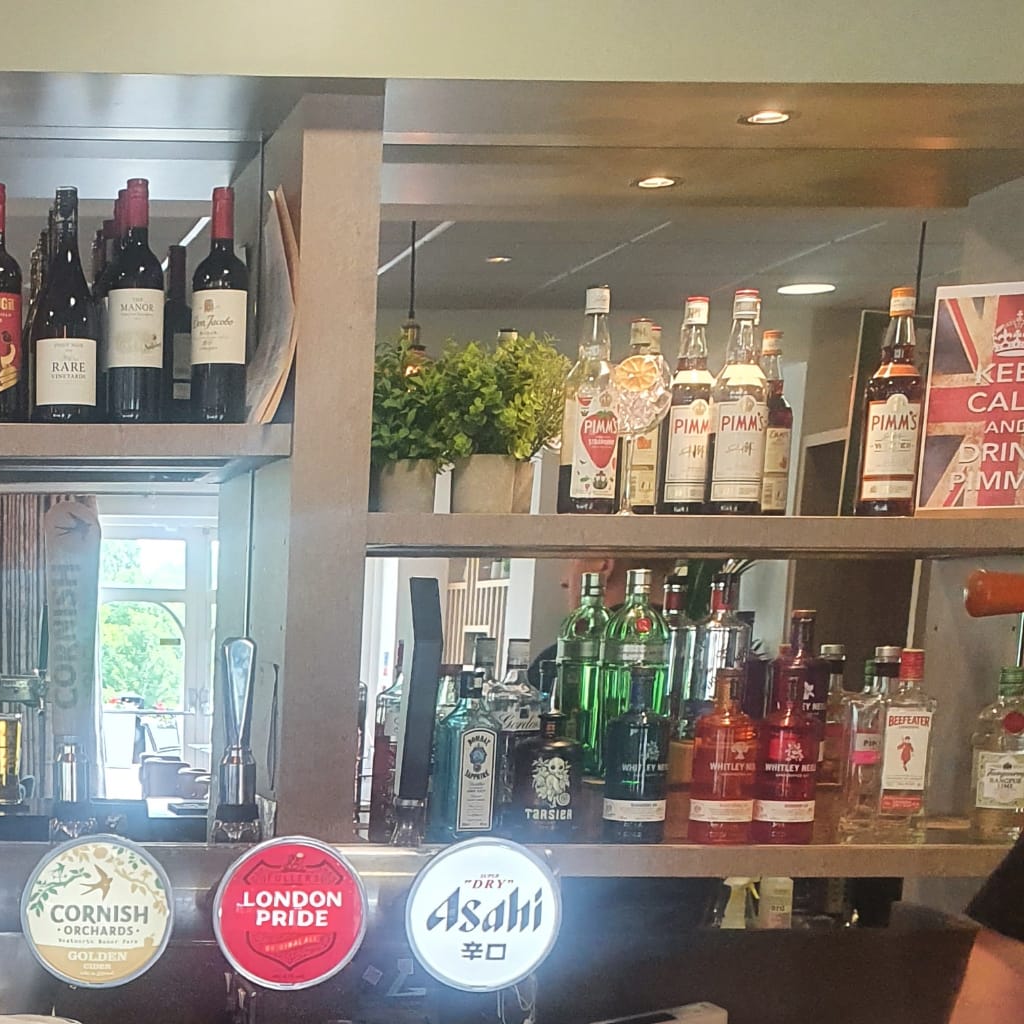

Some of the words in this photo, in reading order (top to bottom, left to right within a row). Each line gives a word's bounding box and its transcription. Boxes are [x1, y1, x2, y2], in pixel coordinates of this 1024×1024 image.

[120, 303, 154, 312] MANOR
[51, 361, 87, 373] RARE
[975, 362, 1024, 384] KEE
[967, 391, 1024, 414] CAL
[674, 418, 710, 435] PIMM
[721, 411, 764, 432] PIMM'S
[872, 410, 918, 432] PIMM'S
[958, 441, 1024, 465] DRIN
[949, 470, 1024, 492] PIMM
[51, 563, 81, 709] CORNISH
[888, 714, 930, 728] BEEFEATER
[709, 762, 745, 772] WHITLEY
[765, 763, 800, 772] WHITLEY
[242, 890, 343, 908] LONDON
[50, 904, 149, 925] CORNISH
[255, 909, 329, 927] PRIDE
[426, 886, 543, 933] Asahi
[63, 925, 134, 936] ORCHARDS
[67, 950, 129, 962] GOLDEN
[461, 940, 507, 961] 辛口
